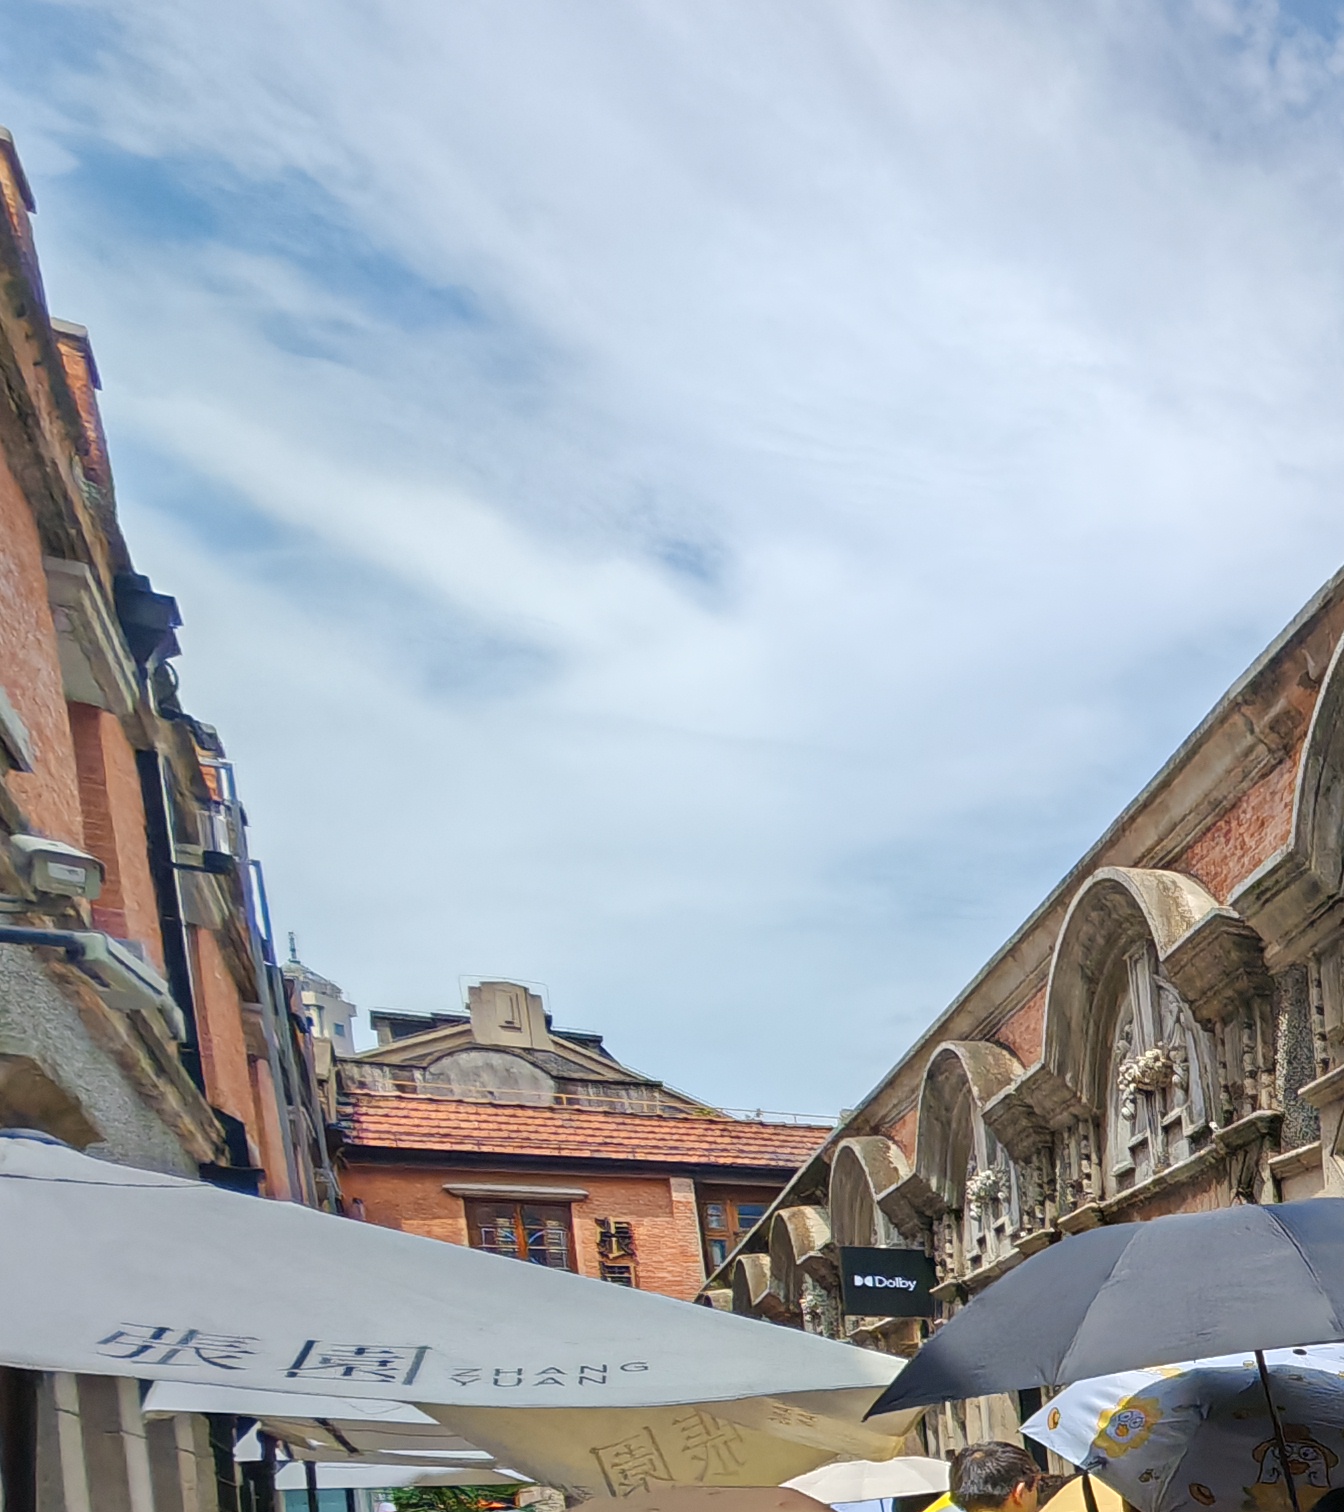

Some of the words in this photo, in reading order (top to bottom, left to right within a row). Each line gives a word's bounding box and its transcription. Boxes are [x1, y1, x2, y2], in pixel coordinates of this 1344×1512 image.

[875, 1276, 917, 1291] Dolby
[96, 1322, 434, 1386] 張園
[450, 1361, 649, 1377] ZHANG
[449, 1376, 607, 1388] YUAN
